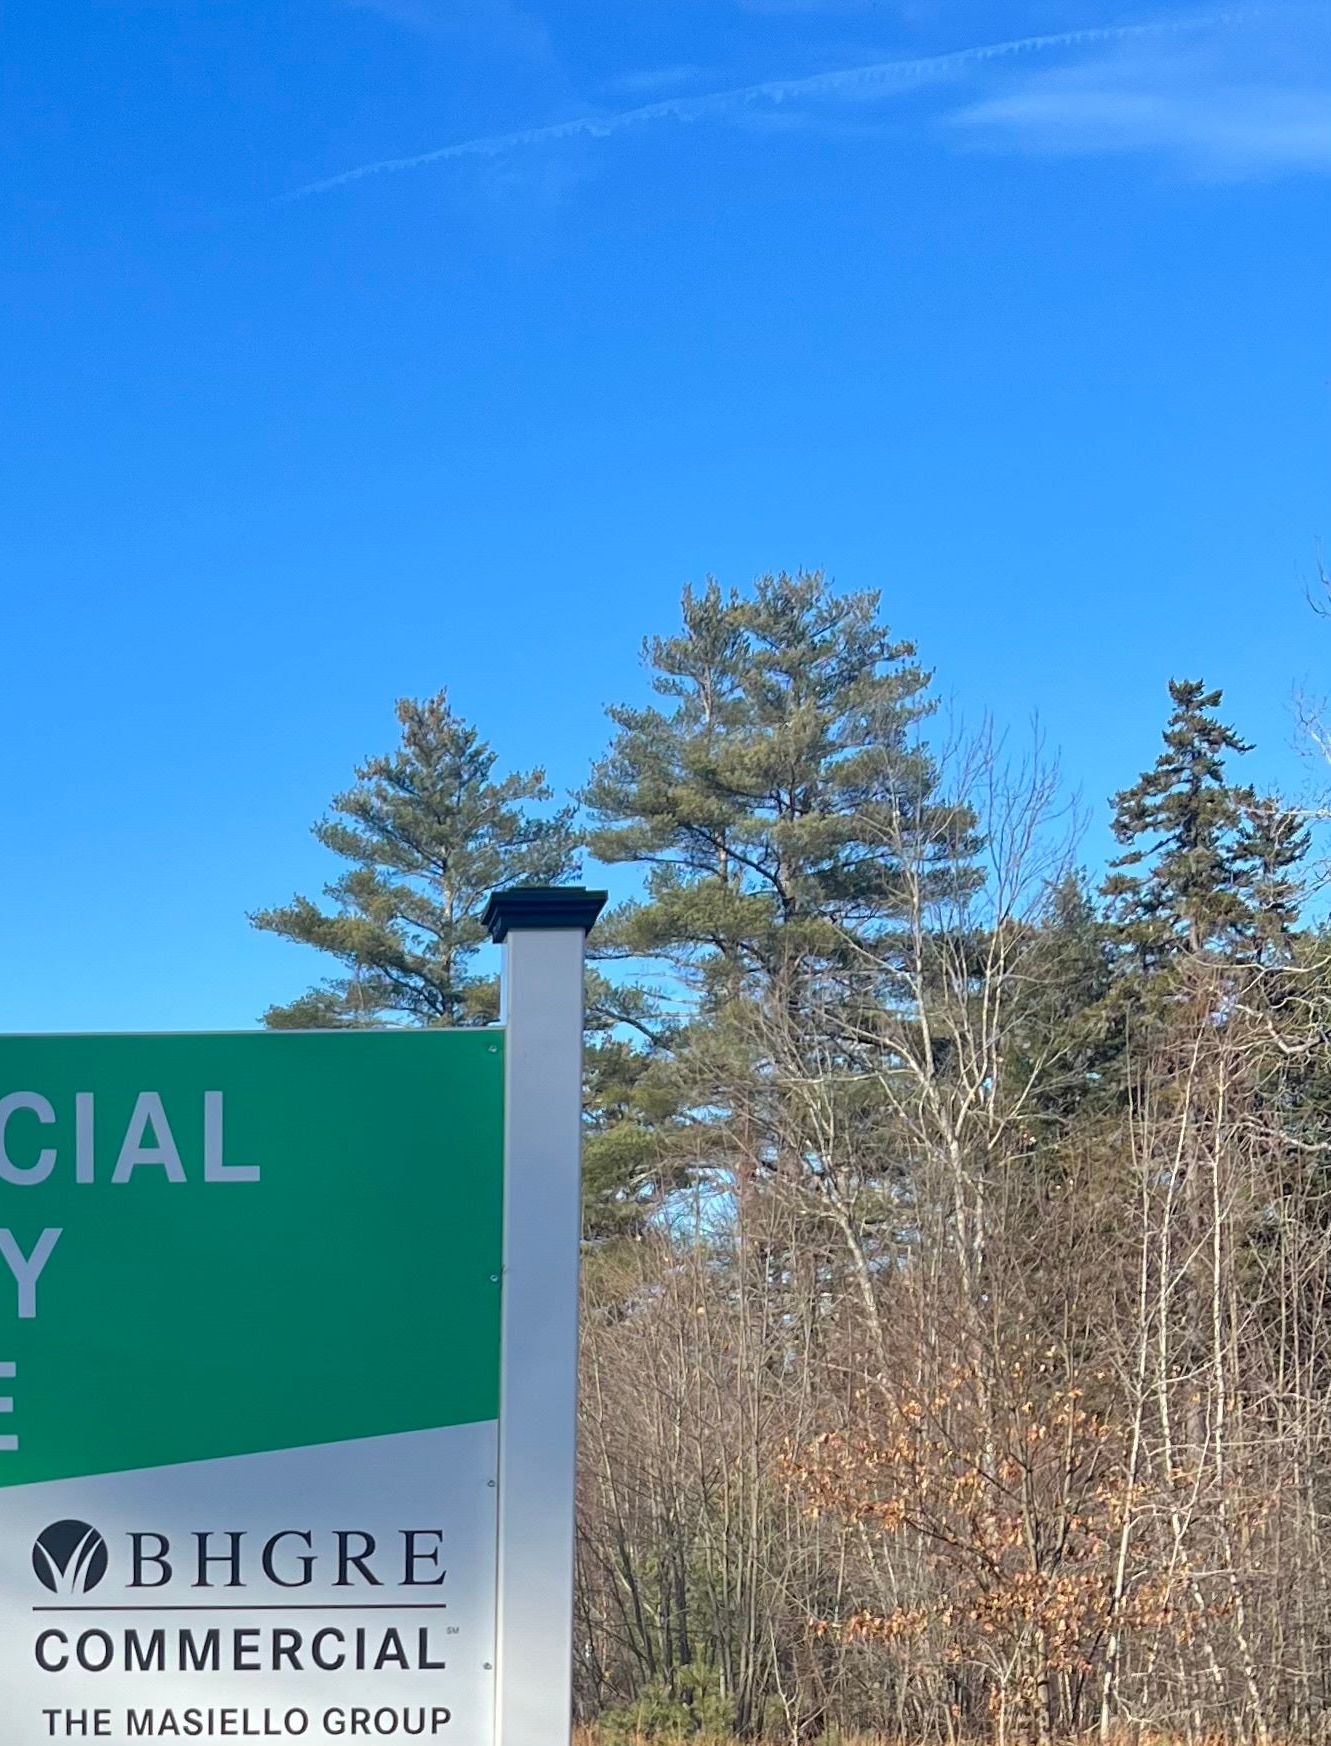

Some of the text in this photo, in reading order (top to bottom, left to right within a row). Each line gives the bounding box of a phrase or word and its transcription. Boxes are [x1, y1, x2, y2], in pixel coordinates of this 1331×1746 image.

[125, 1529, 447, 1588] BHGRE
[35, 1627, 446, 1673] COMMERCIAL
[42, 1707, 451, 1737] THE MASIELLO GROUP
